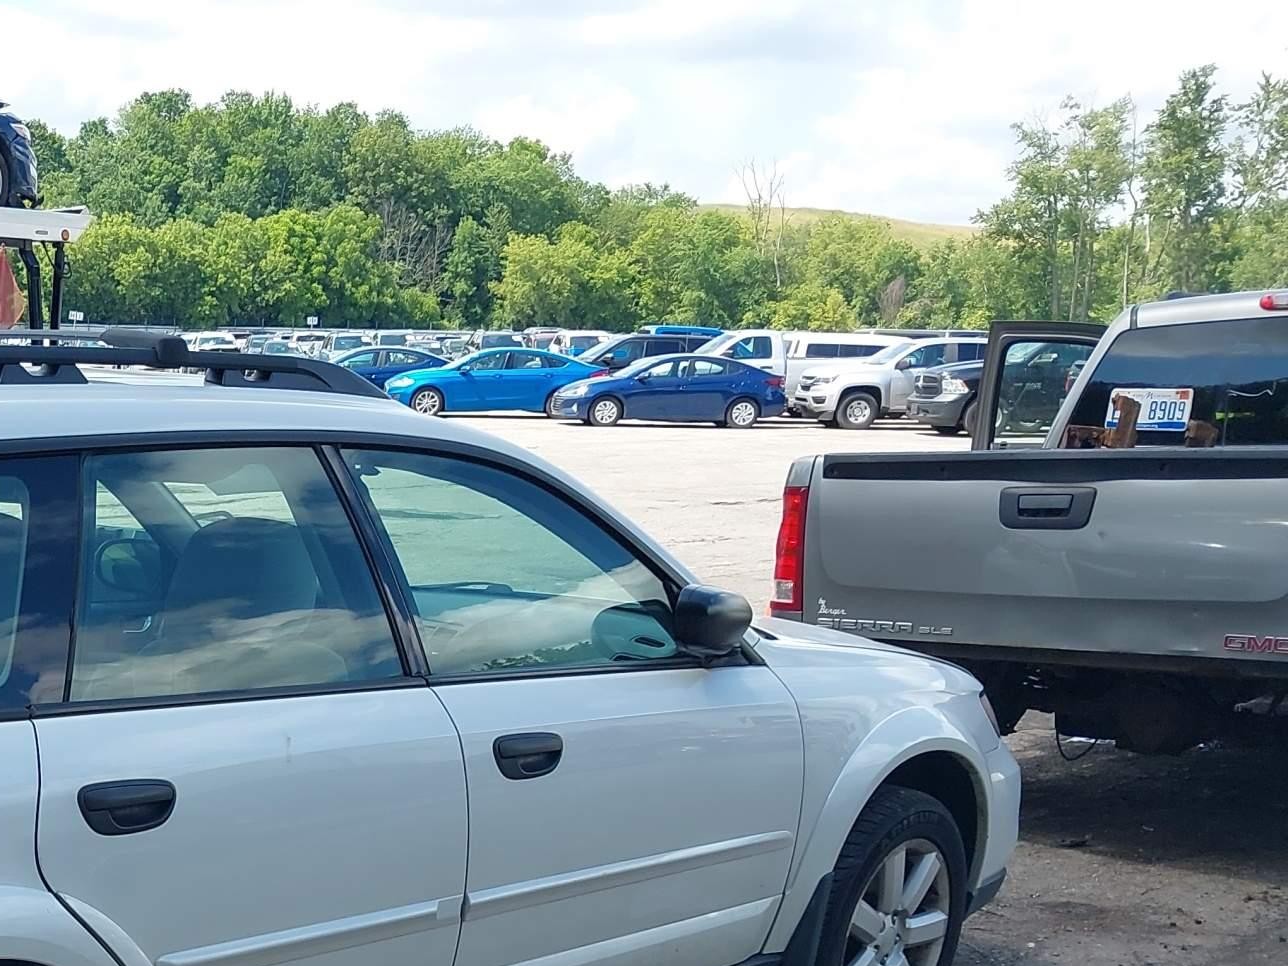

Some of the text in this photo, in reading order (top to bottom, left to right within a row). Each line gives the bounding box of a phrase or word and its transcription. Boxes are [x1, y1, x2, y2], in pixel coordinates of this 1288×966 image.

[1148, 400, 1187, 421] 8909
[816, 617, 953, 635] SIERRA SLE
